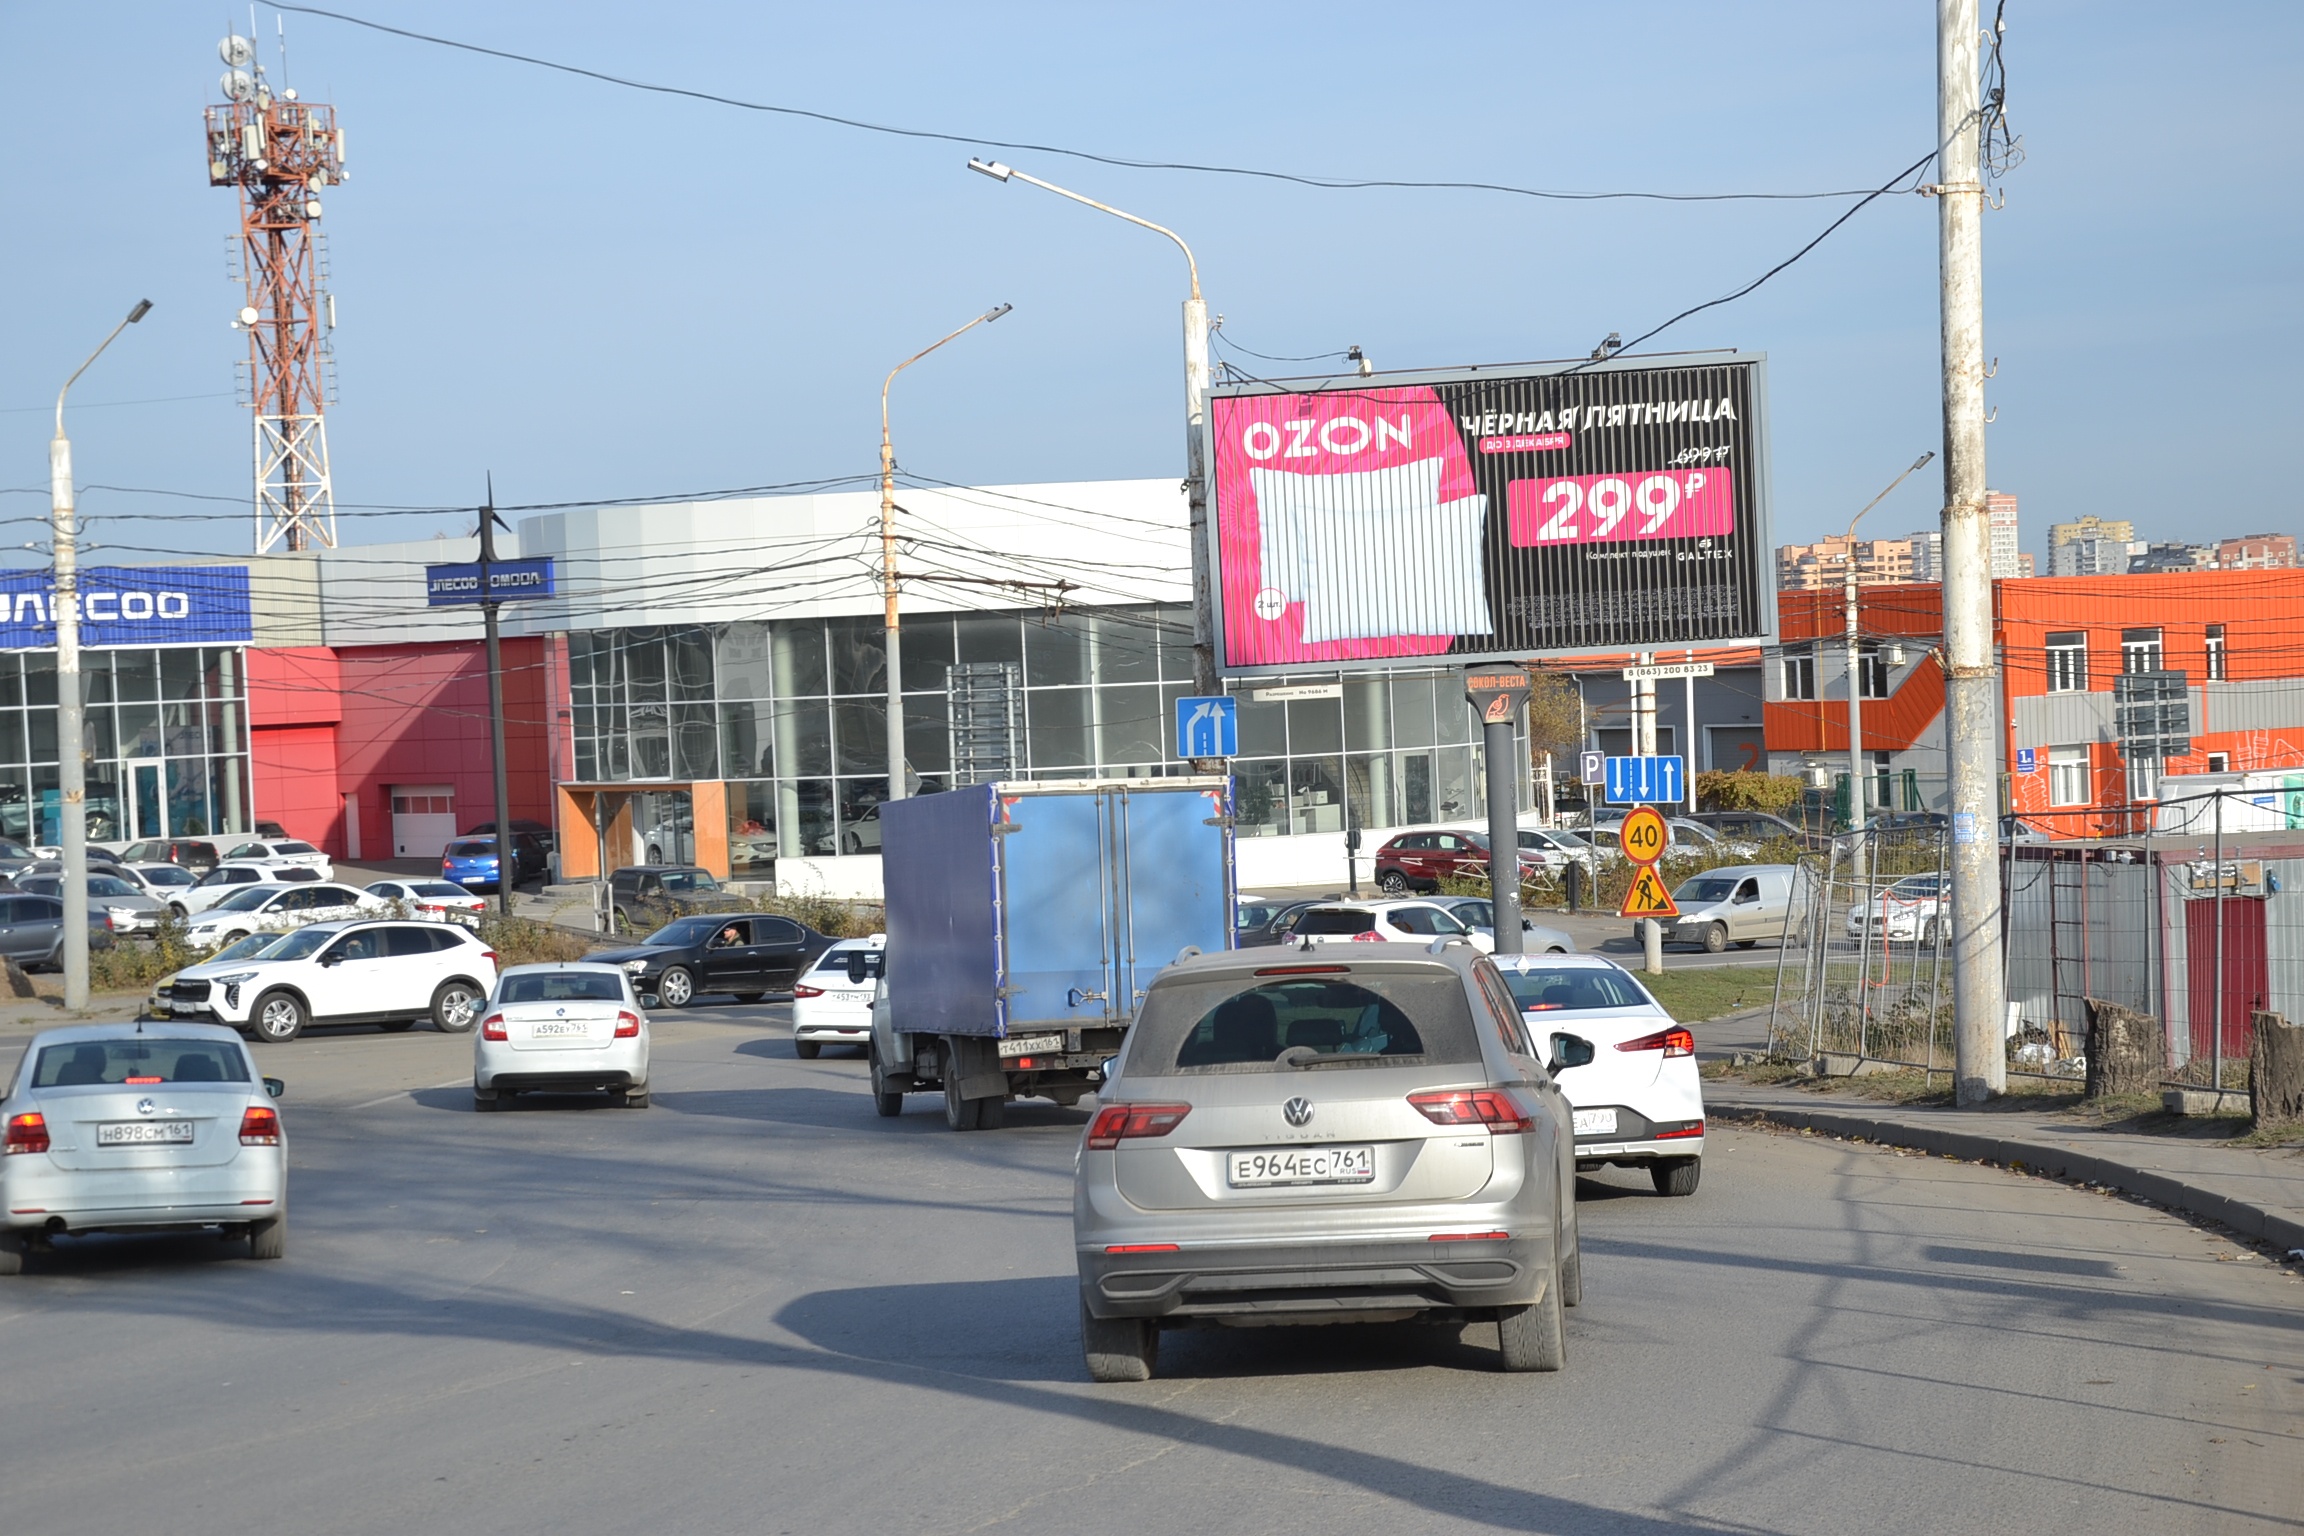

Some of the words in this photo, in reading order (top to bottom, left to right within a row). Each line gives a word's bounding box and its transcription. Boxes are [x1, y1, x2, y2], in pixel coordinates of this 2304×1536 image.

[1460, 405, 1580, 436] ЧЁРНАЯ
[1579, 398, 1737, 434] ПЯТНИЦА
[1244, 414, 1411, 460] OZON
[1486, 441, 1502, 450] ДО
[1512, 437, 1564, 449] ДЕКАБРЯ
[1676, 550, 1733, 560] GALTEX
[1257, 600, 1265, 608] 2
[1636, 667, 1661, 677] (863)
[1663, 666, 1681, 674] 200
[1683, 665, 1695, 673] 83
[1467, 675, 1526, 688] СОКОЛ-ВЕСТА
[1630, 824, 1658, 848] 40
[1238, 1153, 1327, 1178] Е964ЕС
[1331, 1150, 1367, 1168] 761
